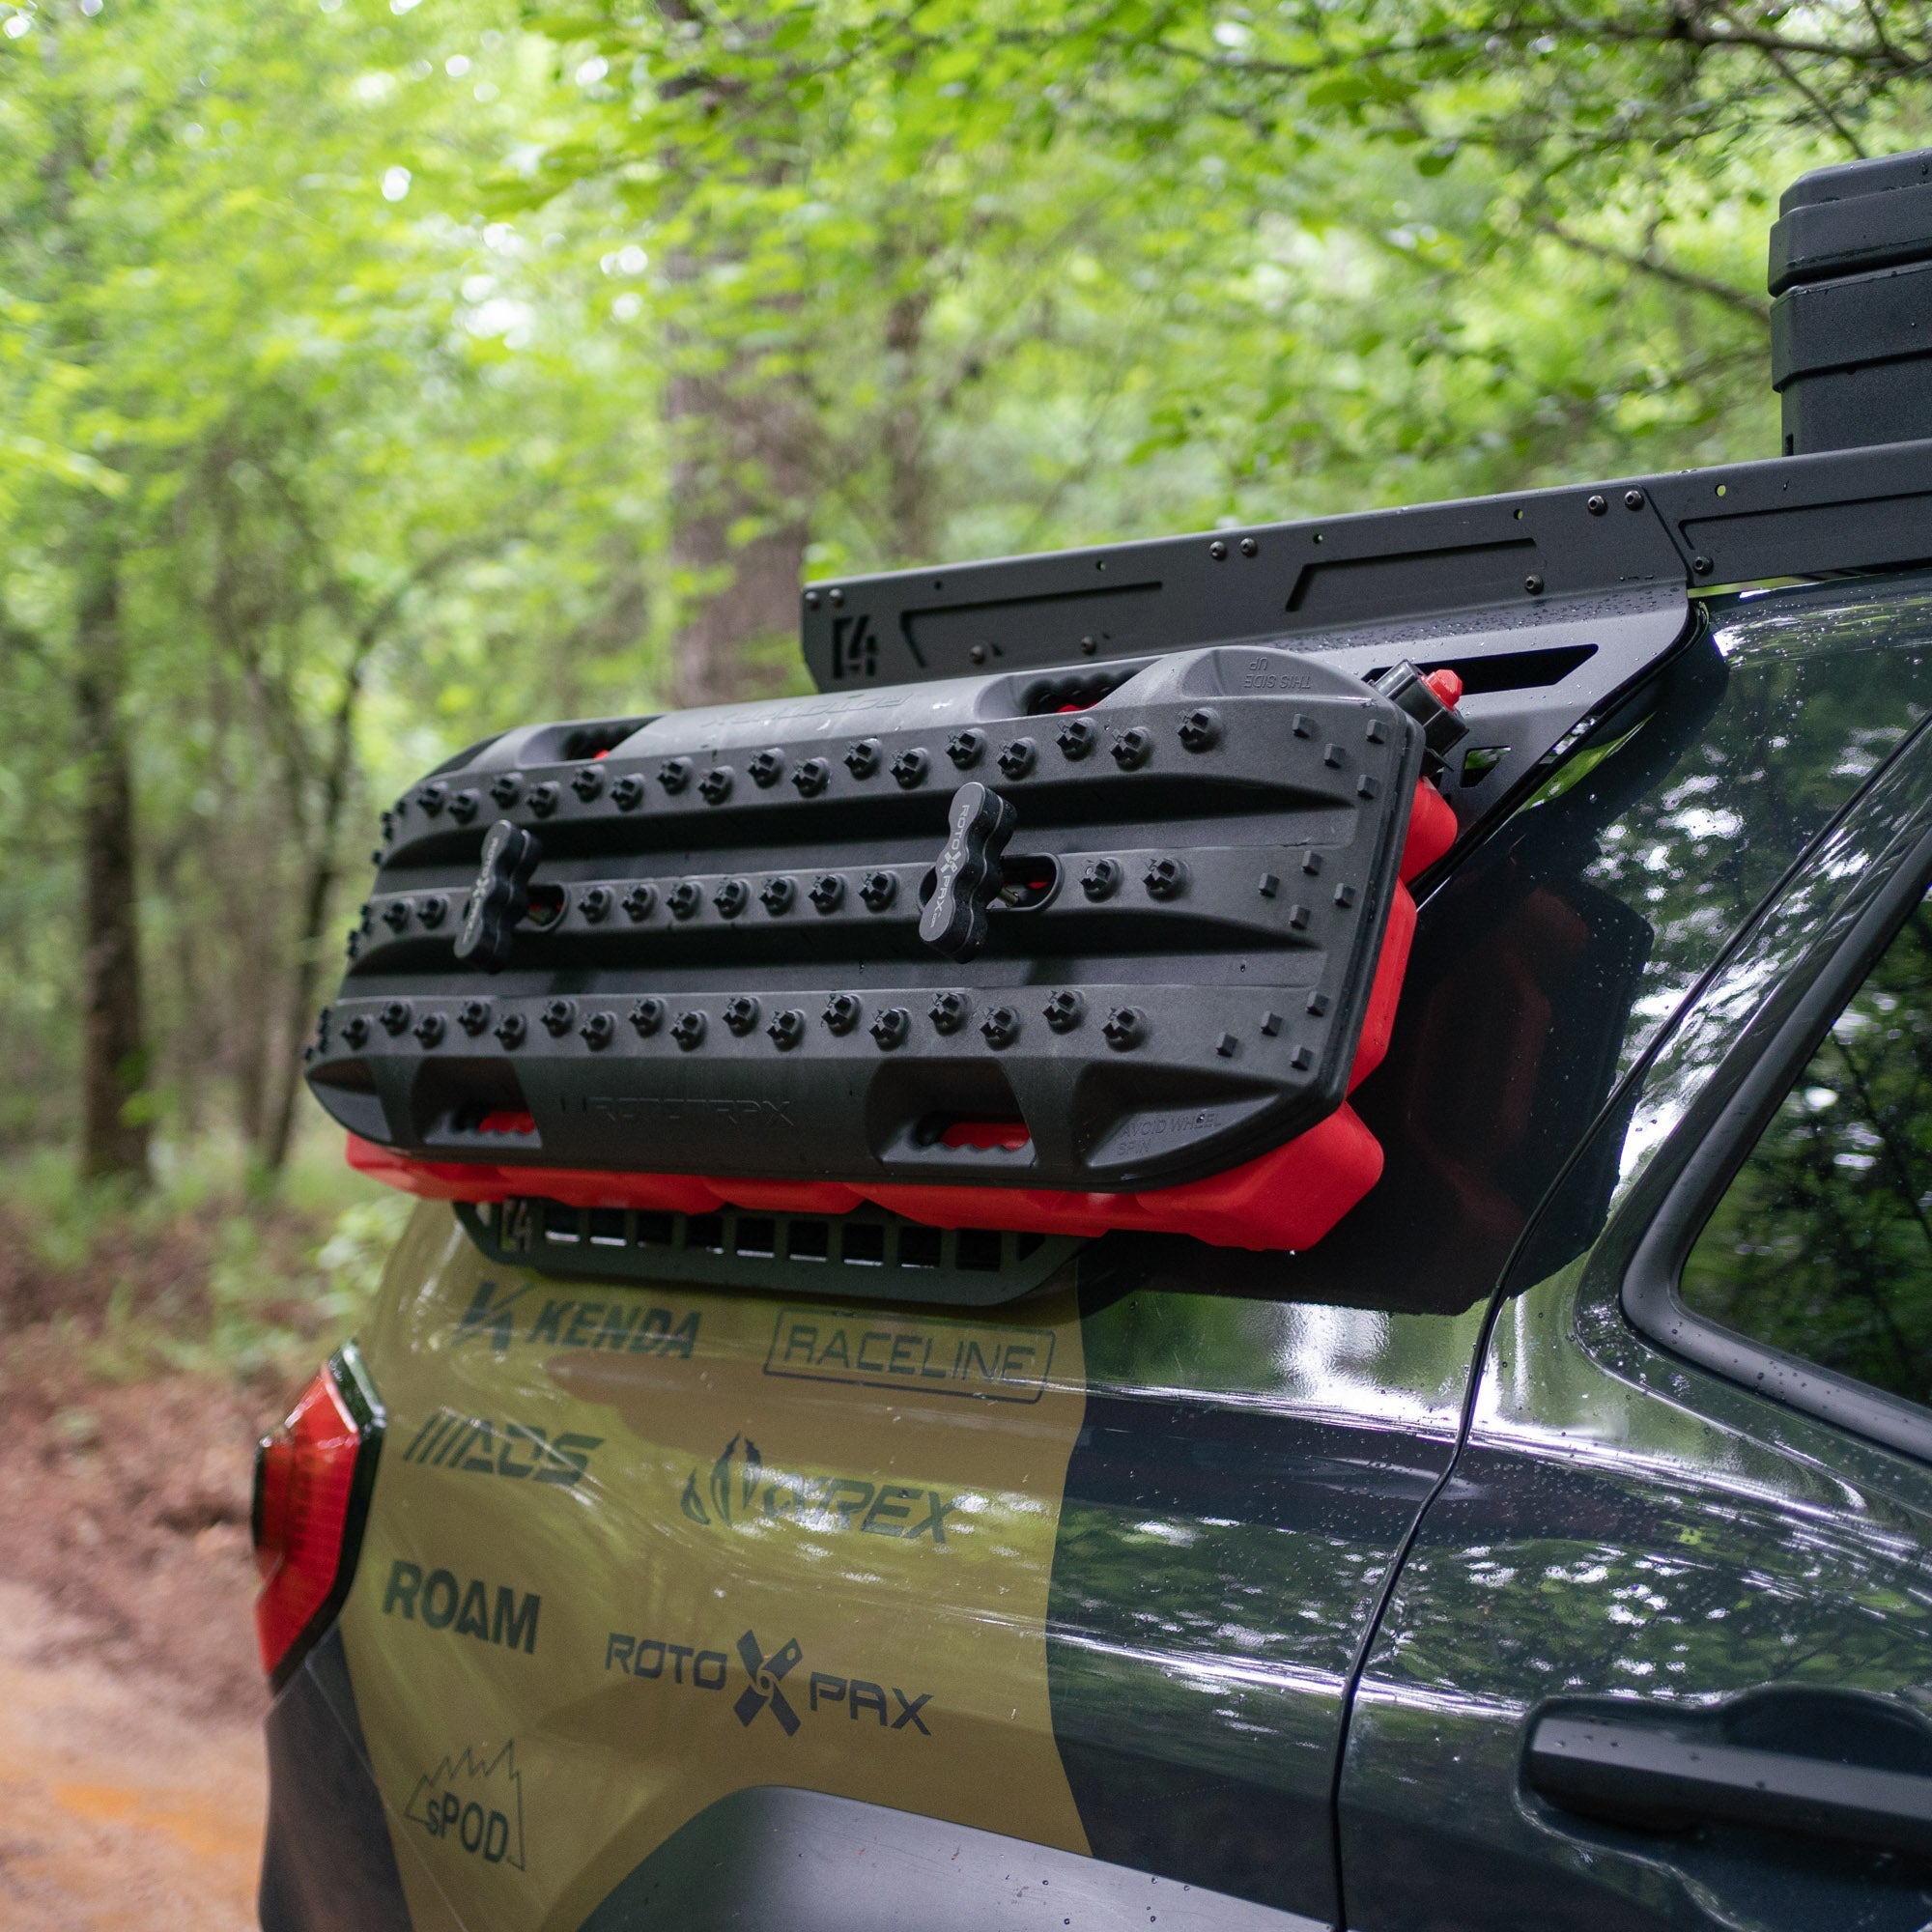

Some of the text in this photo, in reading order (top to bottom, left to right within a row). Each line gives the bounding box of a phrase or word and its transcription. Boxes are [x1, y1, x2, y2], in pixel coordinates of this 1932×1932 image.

[1243, 673, 1311, 689] THIS SIDE
[1249, 656, 1268, 671] UP
[952, 804, 970, 851] ROTO
[1119, 1119, 1166, 1139] AVOID
[526, 1299, 702, 1359] KENDA
[784, 1324, 1036, 1386] RACELINE
[383, 1559, 540, 1655] ROAM
[605, 1632, 728, 1690] ROTO
[810, 1671, 934, 1736] PAX
[427, 1791, 508, 1862] sPOD
